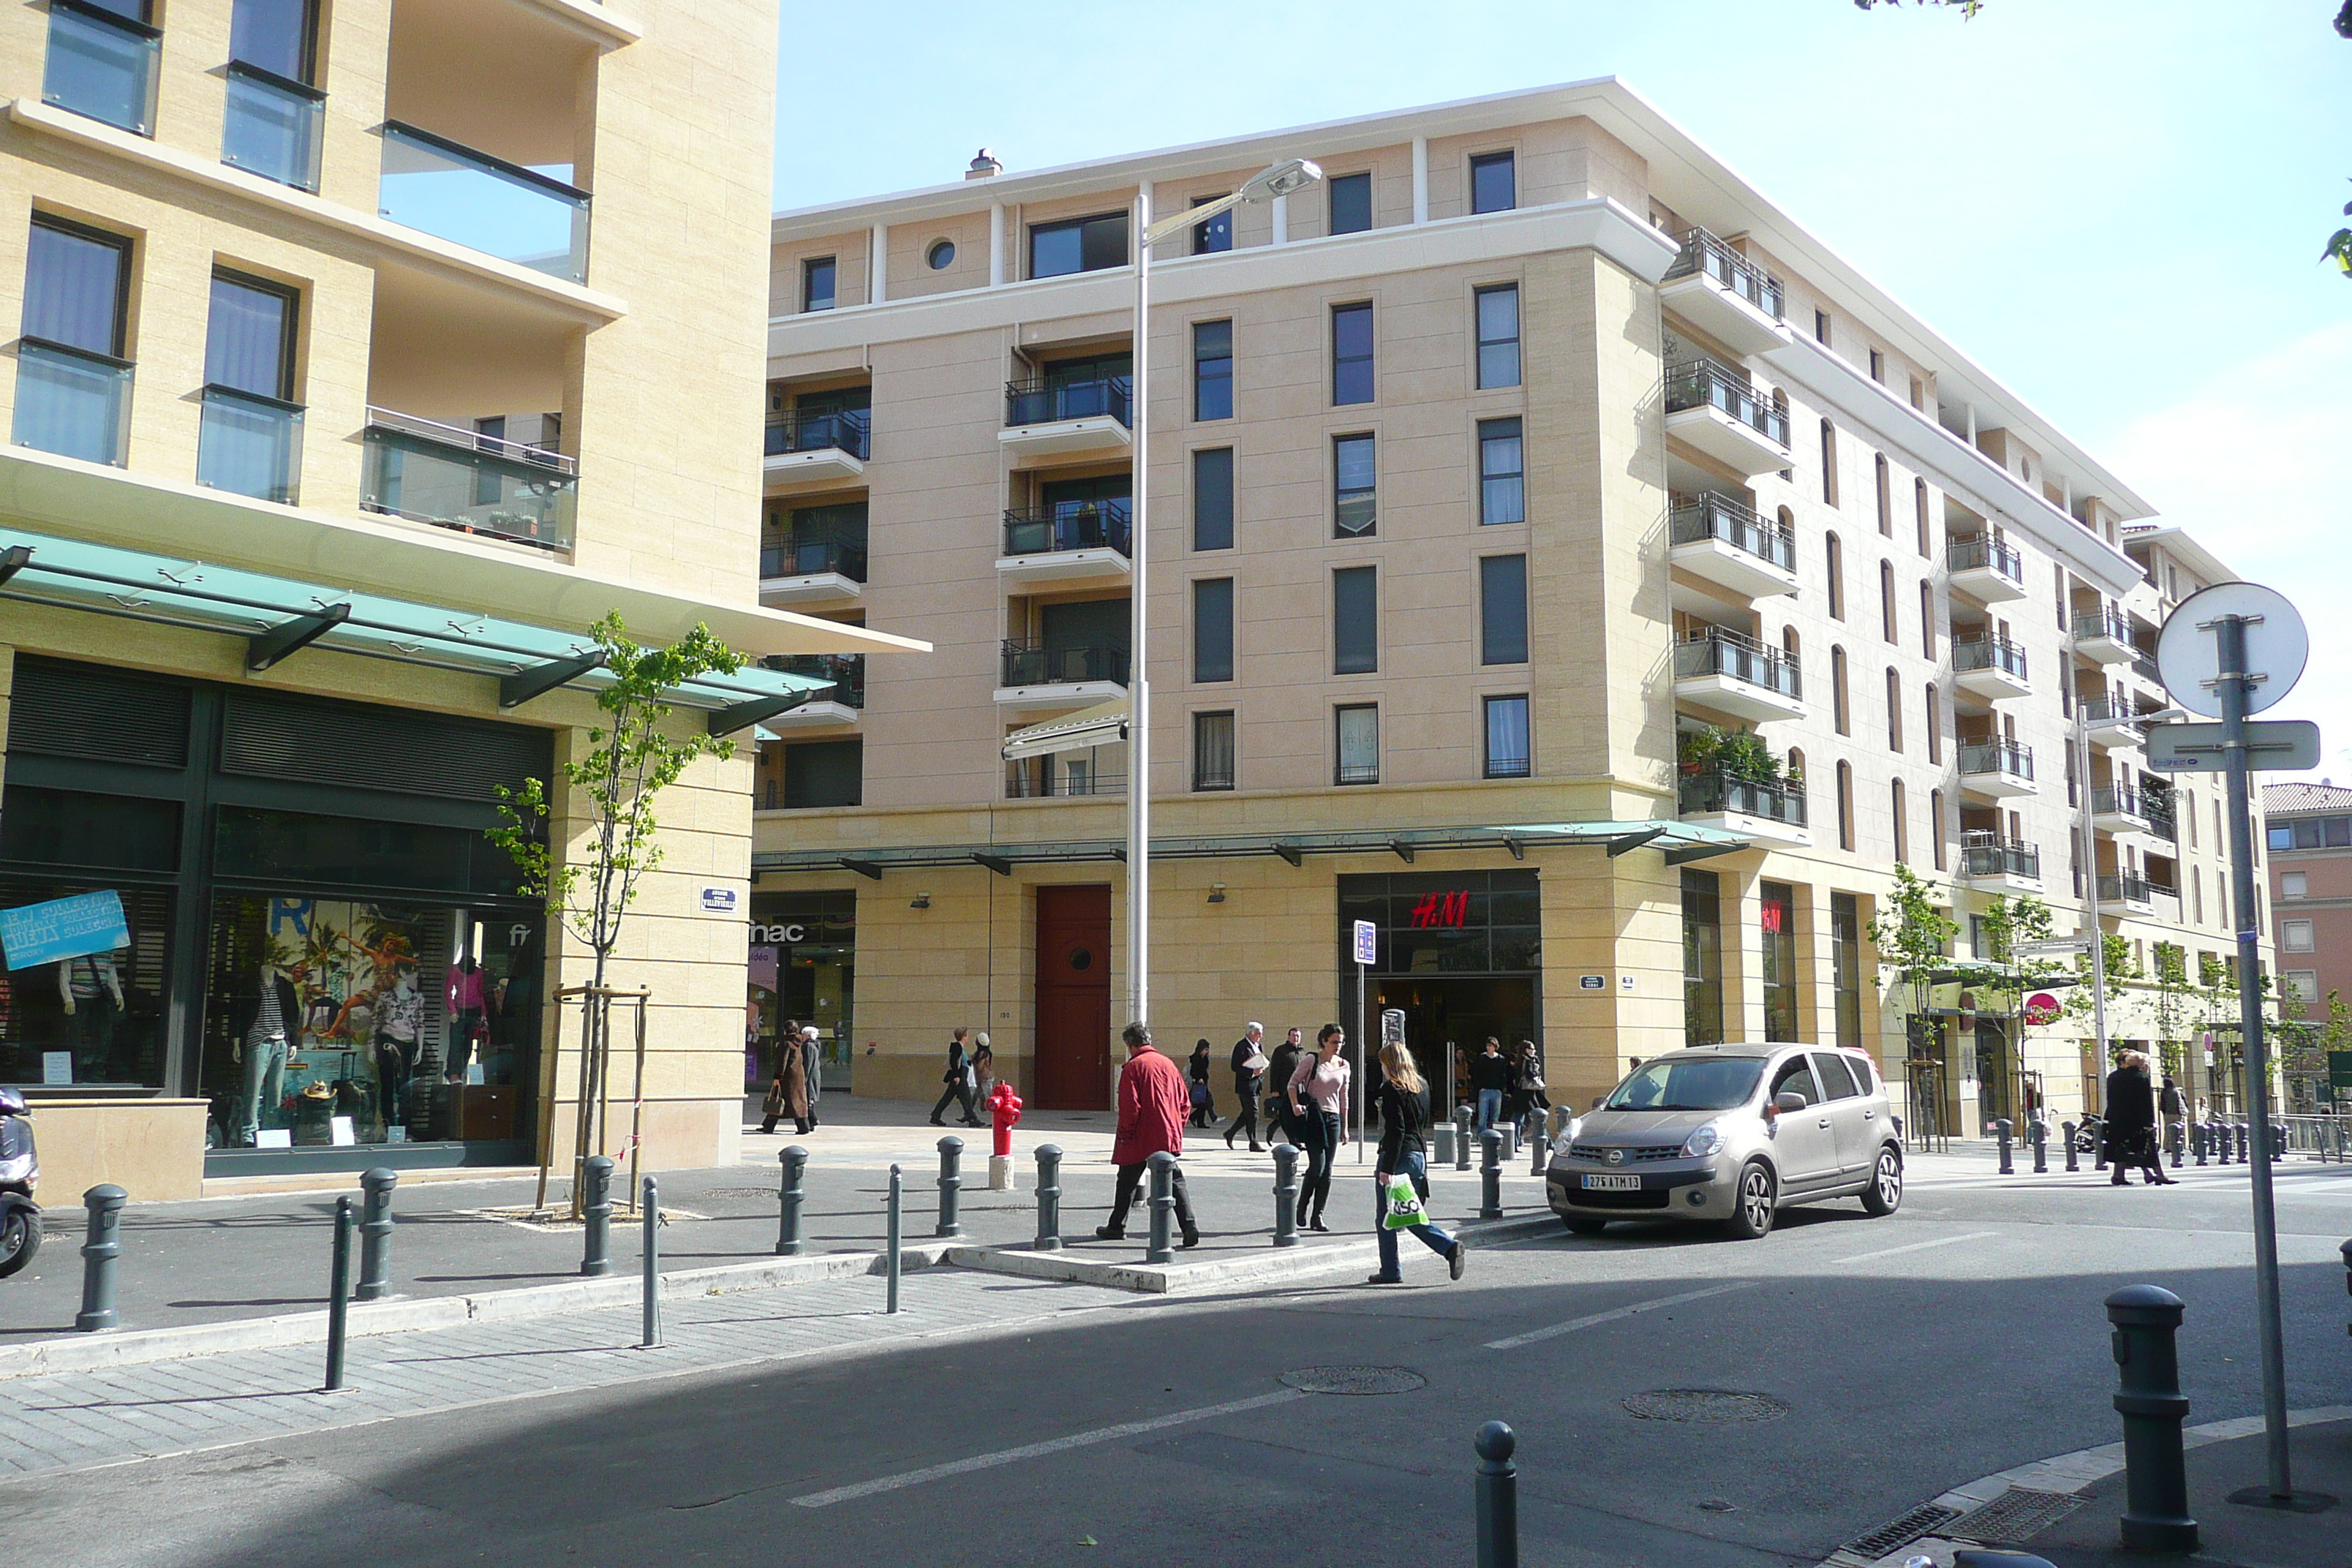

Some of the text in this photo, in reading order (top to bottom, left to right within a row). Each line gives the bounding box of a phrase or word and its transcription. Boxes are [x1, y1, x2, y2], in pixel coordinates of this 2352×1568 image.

[1410, 890, 1469, 930] H&M
[750, 919, 804, 942] nac
[1629, 1177, 1638, 1188] 13
